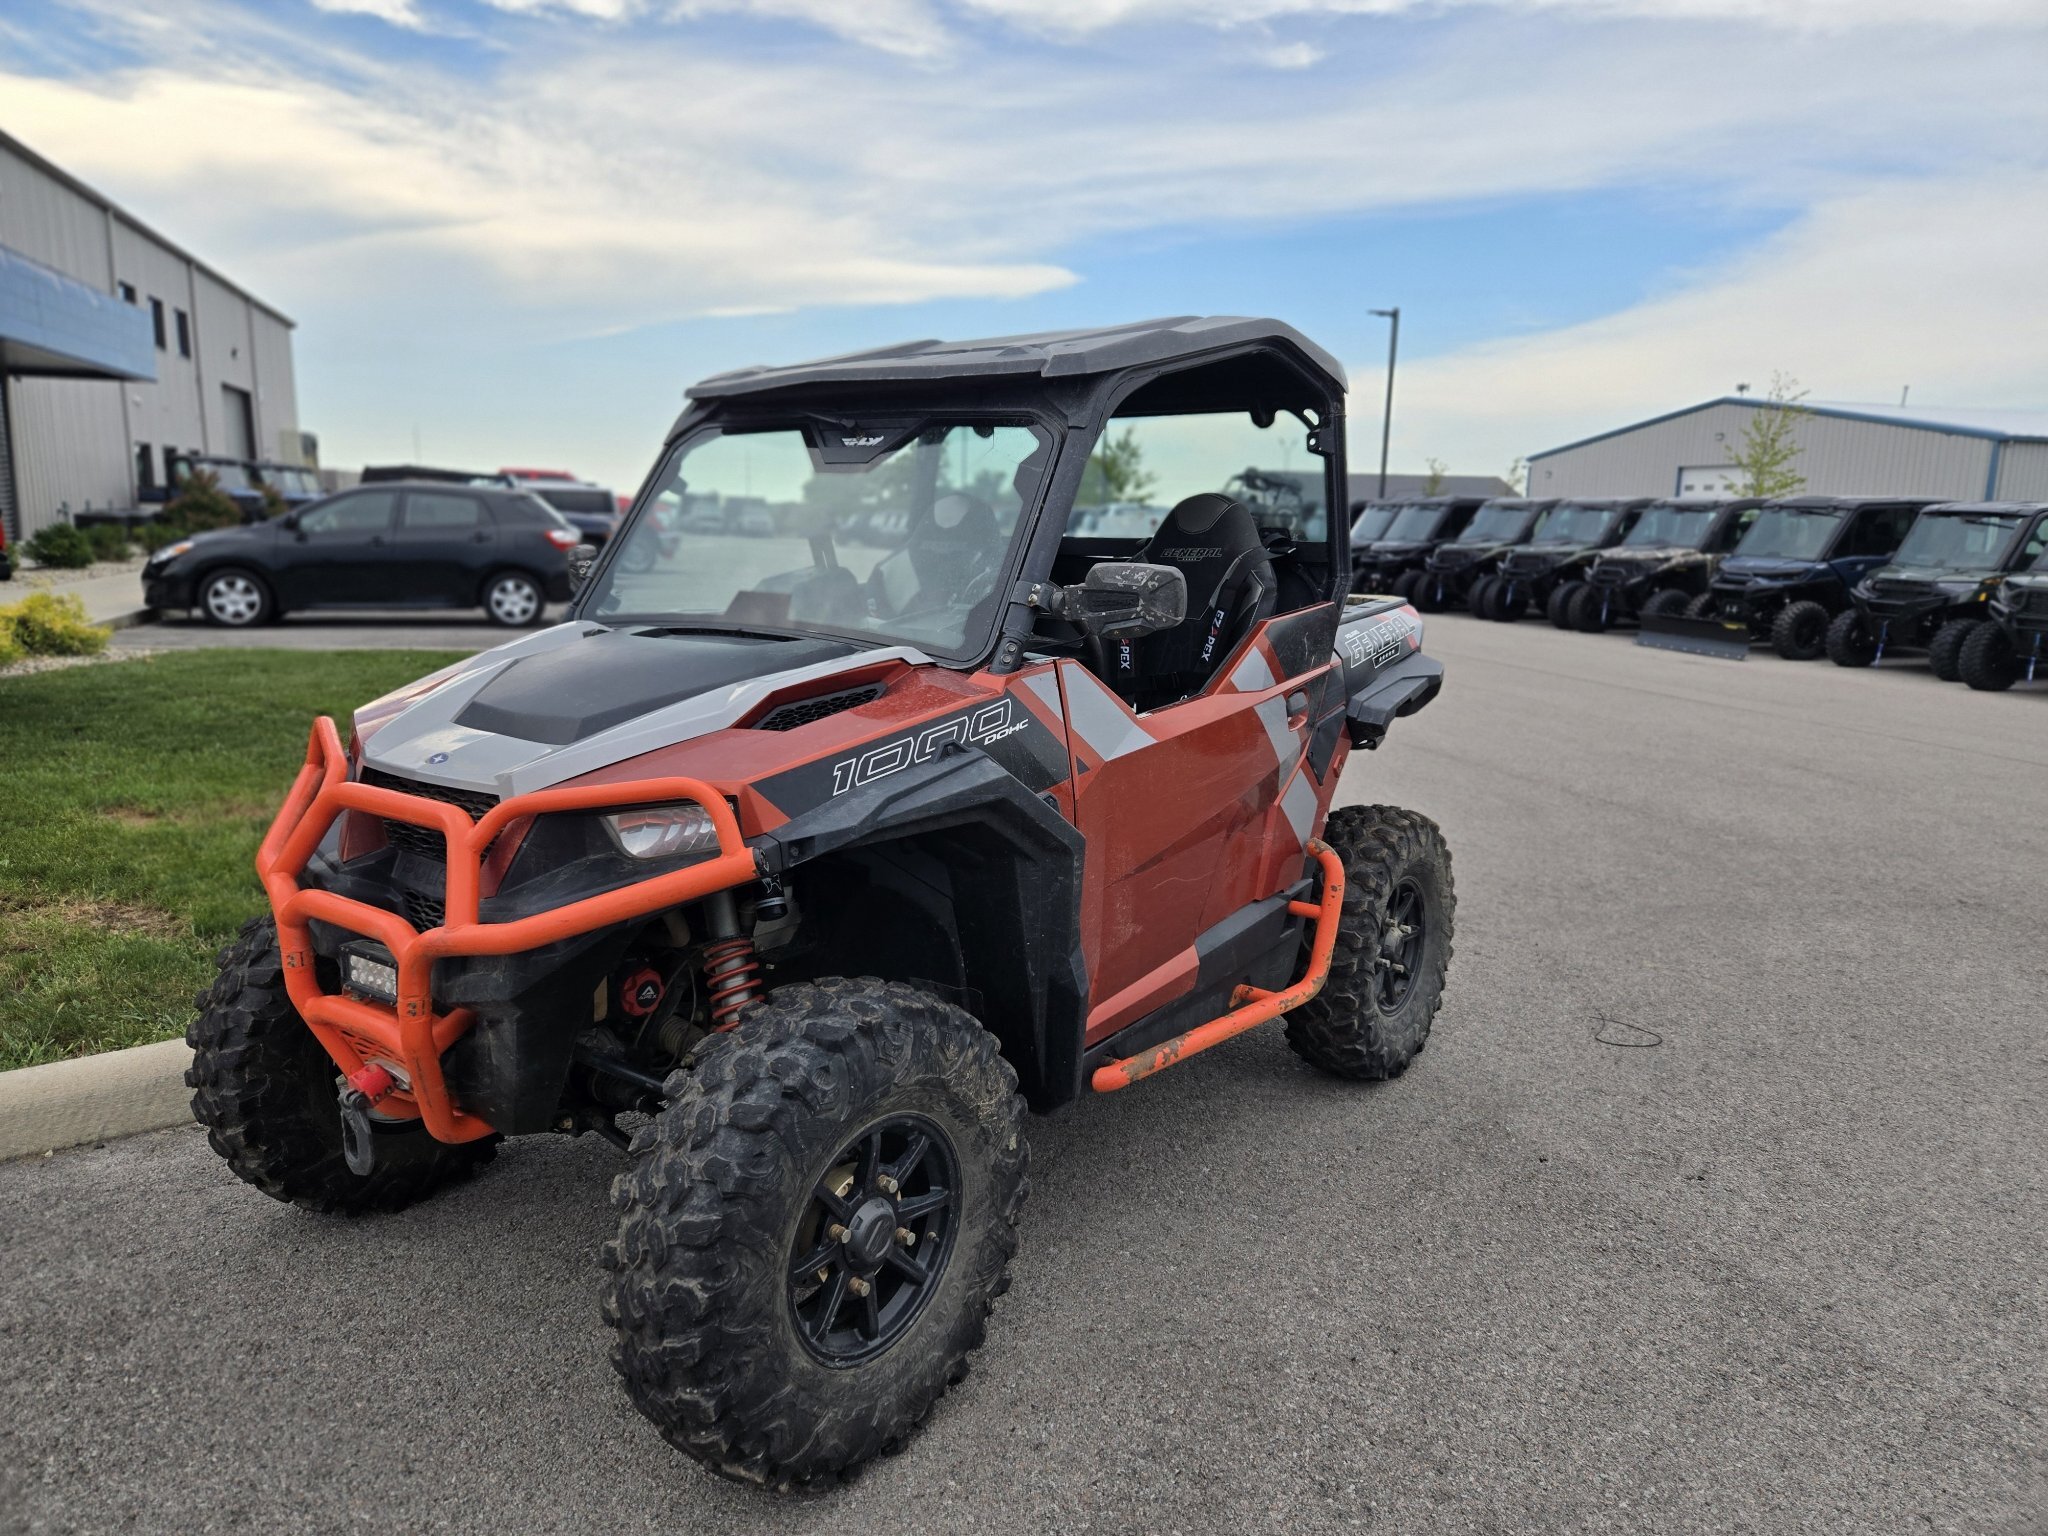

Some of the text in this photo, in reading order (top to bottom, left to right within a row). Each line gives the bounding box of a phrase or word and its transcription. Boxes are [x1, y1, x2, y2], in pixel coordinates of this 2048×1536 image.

[1160, 547, 1223, 558] GENERAL
[1345, 613, 1416, 668] GENERAL
[832, 698, 1012, 797] 1000
[983, 718, 1029, 746] DOHC
